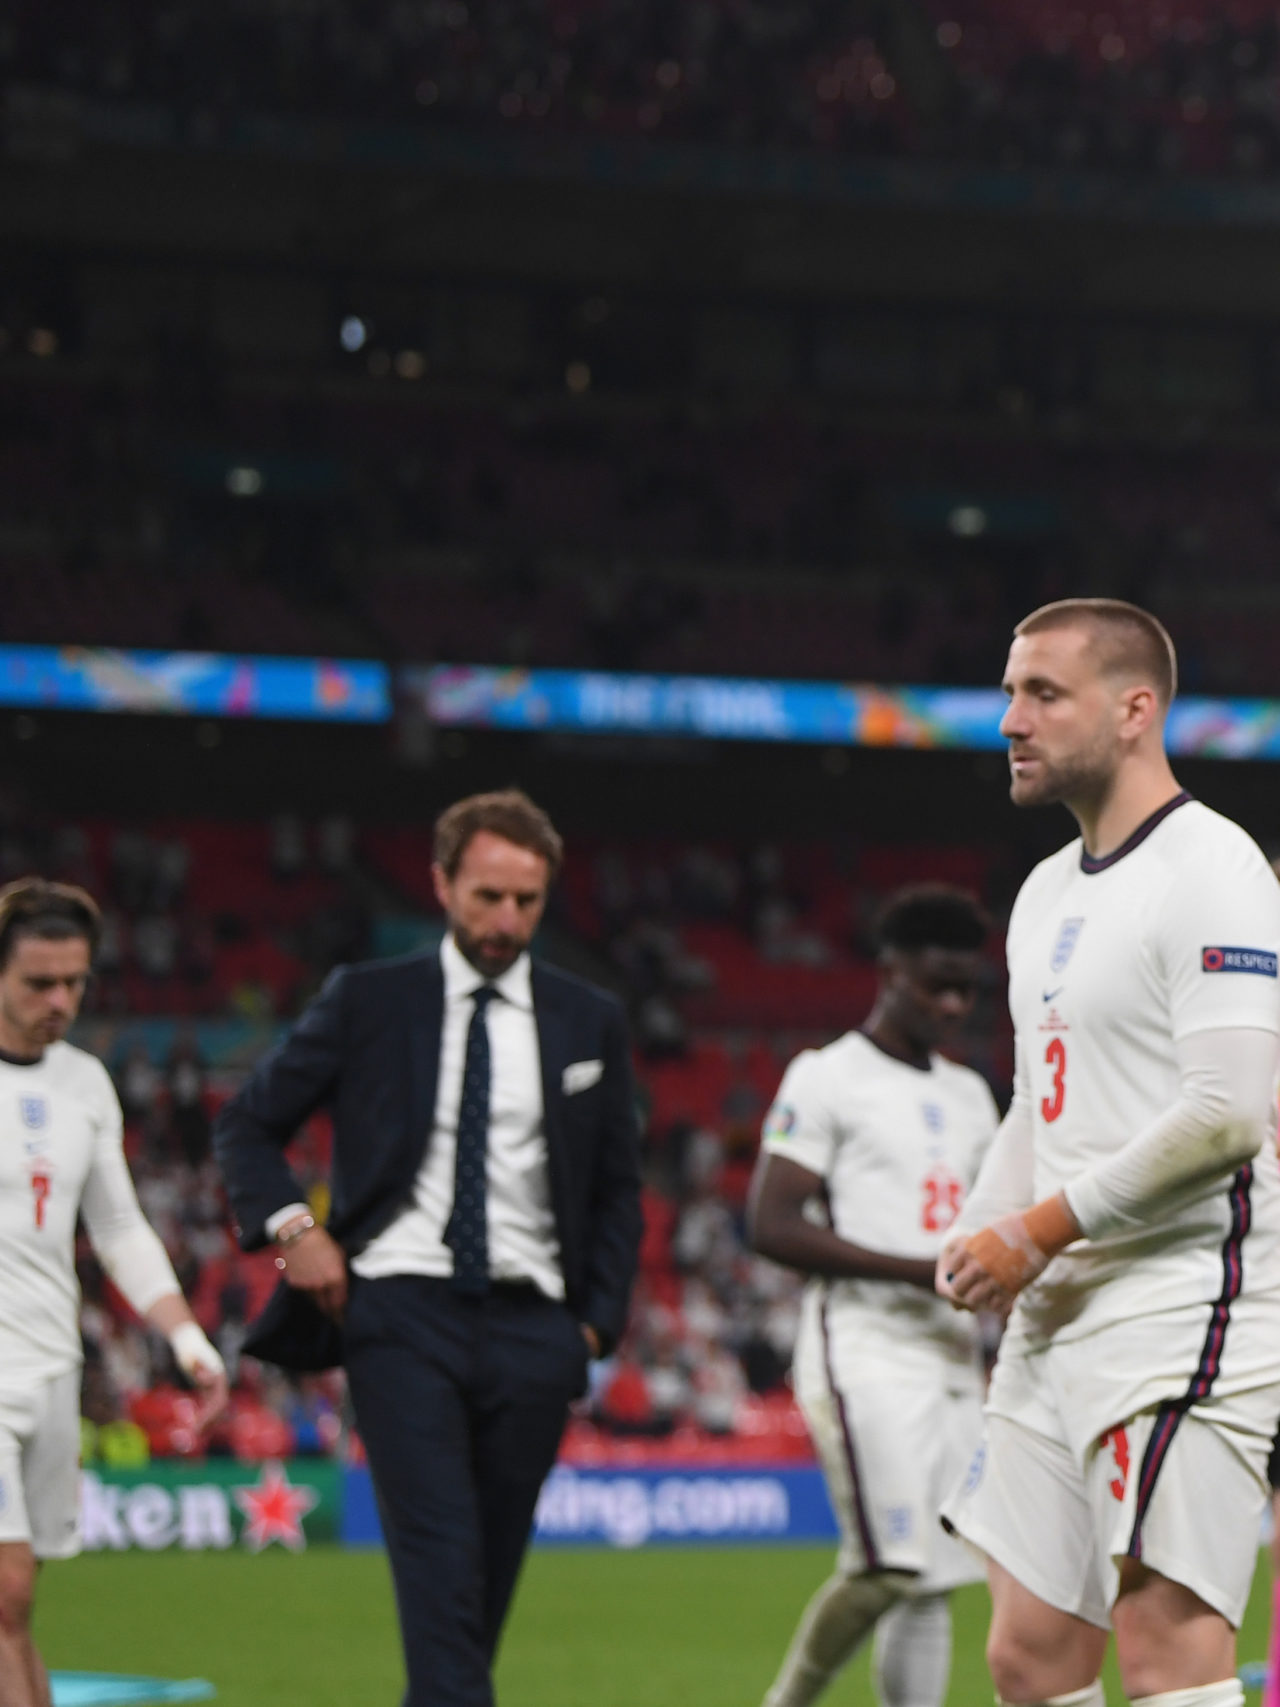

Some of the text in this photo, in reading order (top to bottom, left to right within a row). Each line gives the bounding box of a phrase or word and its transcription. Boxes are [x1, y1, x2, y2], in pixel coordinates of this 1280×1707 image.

[1224, 952, 1277, 971] RESPECT
[1041, 1038, 1066, 1124] 3
[31, 1174, 51, 1231] 7
